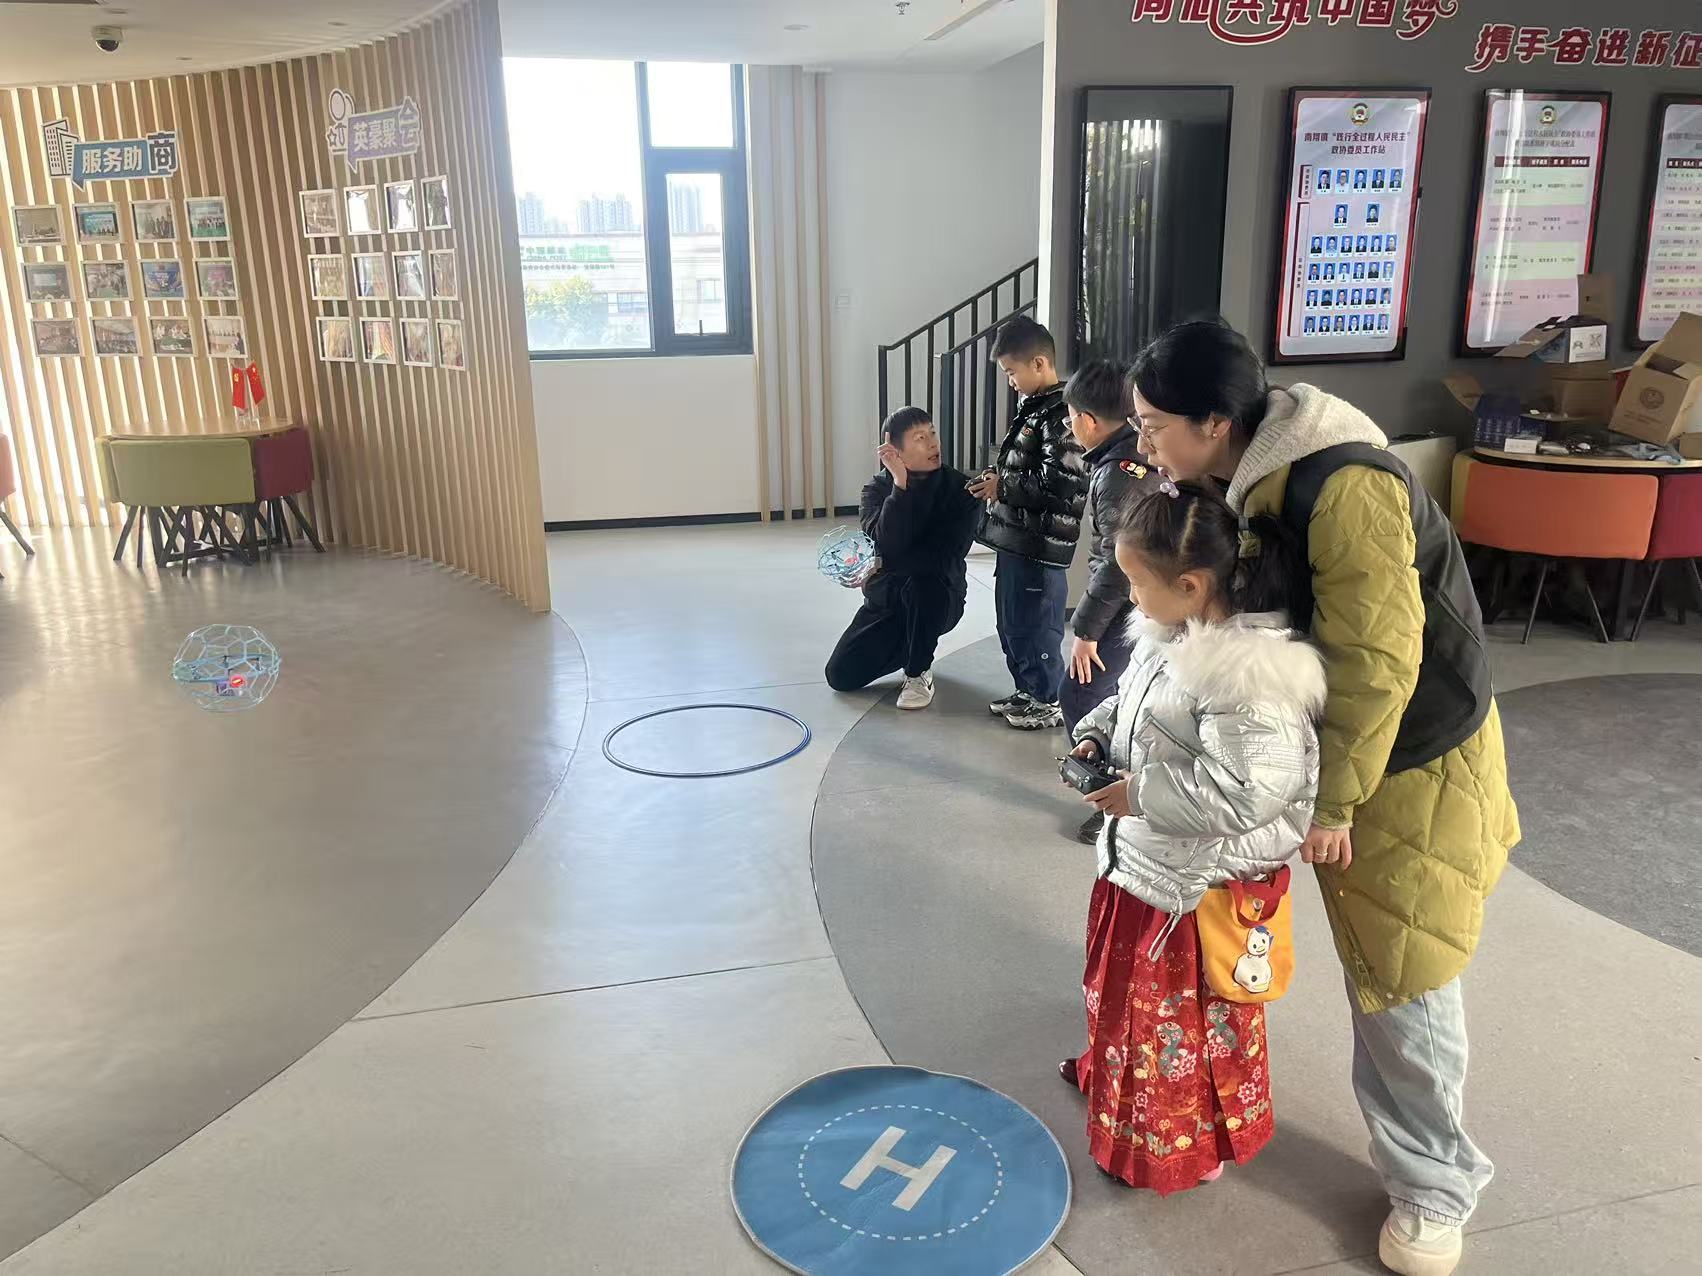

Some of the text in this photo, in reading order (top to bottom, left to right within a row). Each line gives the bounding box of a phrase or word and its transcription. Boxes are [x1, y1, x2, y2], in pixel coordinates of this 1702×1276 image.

[82, 132, 177, 174] 服务助商
[840, 1126, 957, 1211] H
